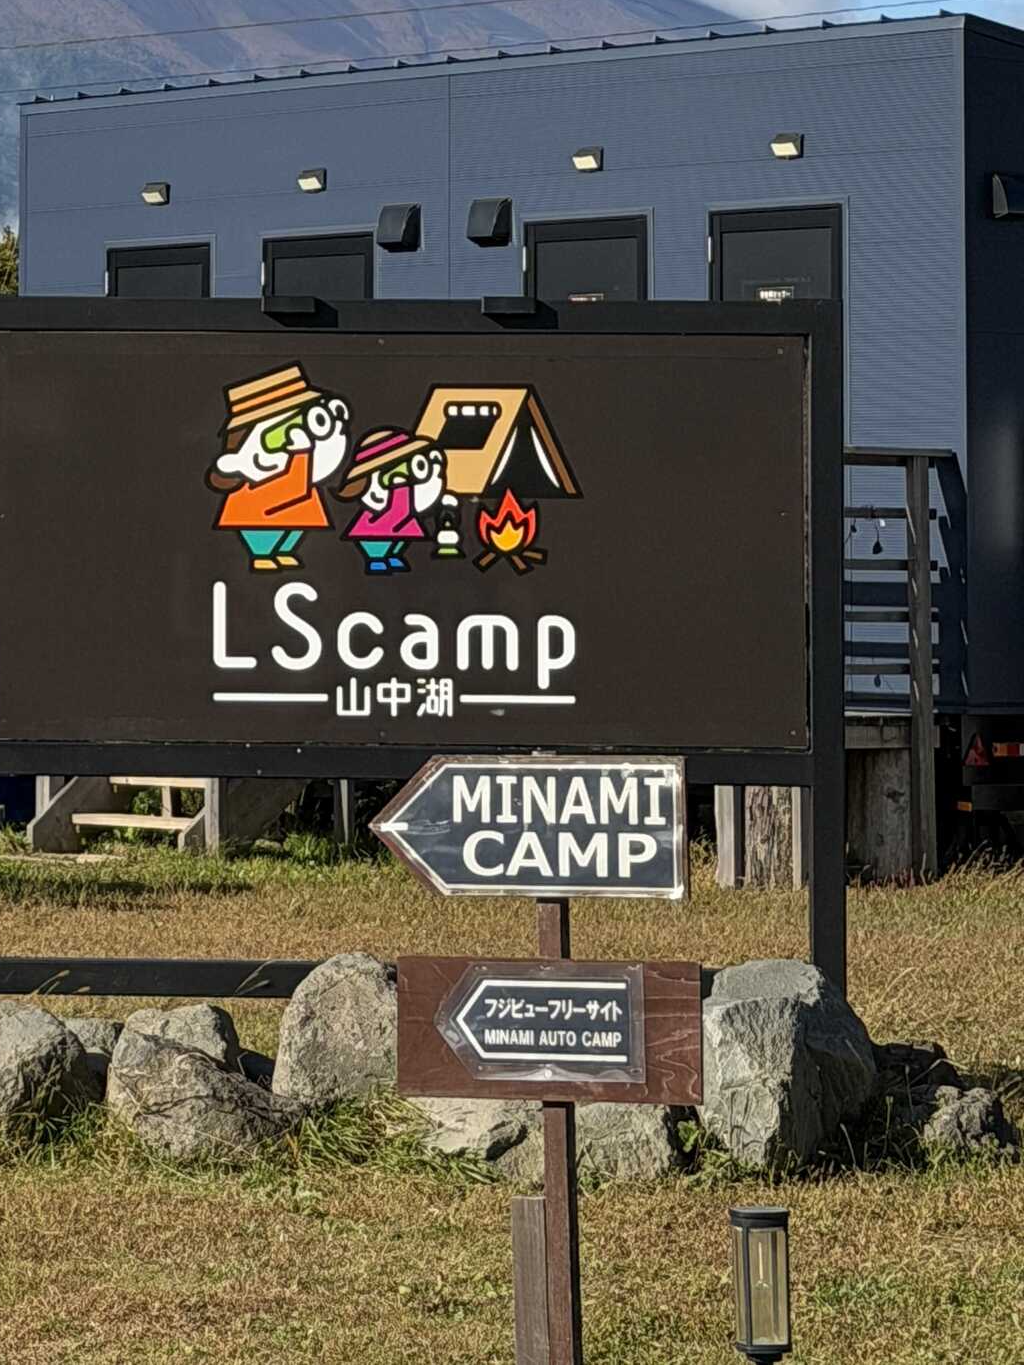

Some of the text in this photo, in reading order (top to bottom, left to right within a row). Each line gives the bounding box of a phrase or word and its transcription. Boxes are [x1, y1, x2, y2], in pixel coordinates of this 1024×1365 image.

[336, 677, 454, 717] 山中湖
[452, 774, 667, 826] MINAMI
[462, 830, 658, 878] CAMP
[484, 998, 623, 1022] フジビューフリーサイト
[484, 1028, 622, 1048] MINAMI AUTO CAMP
